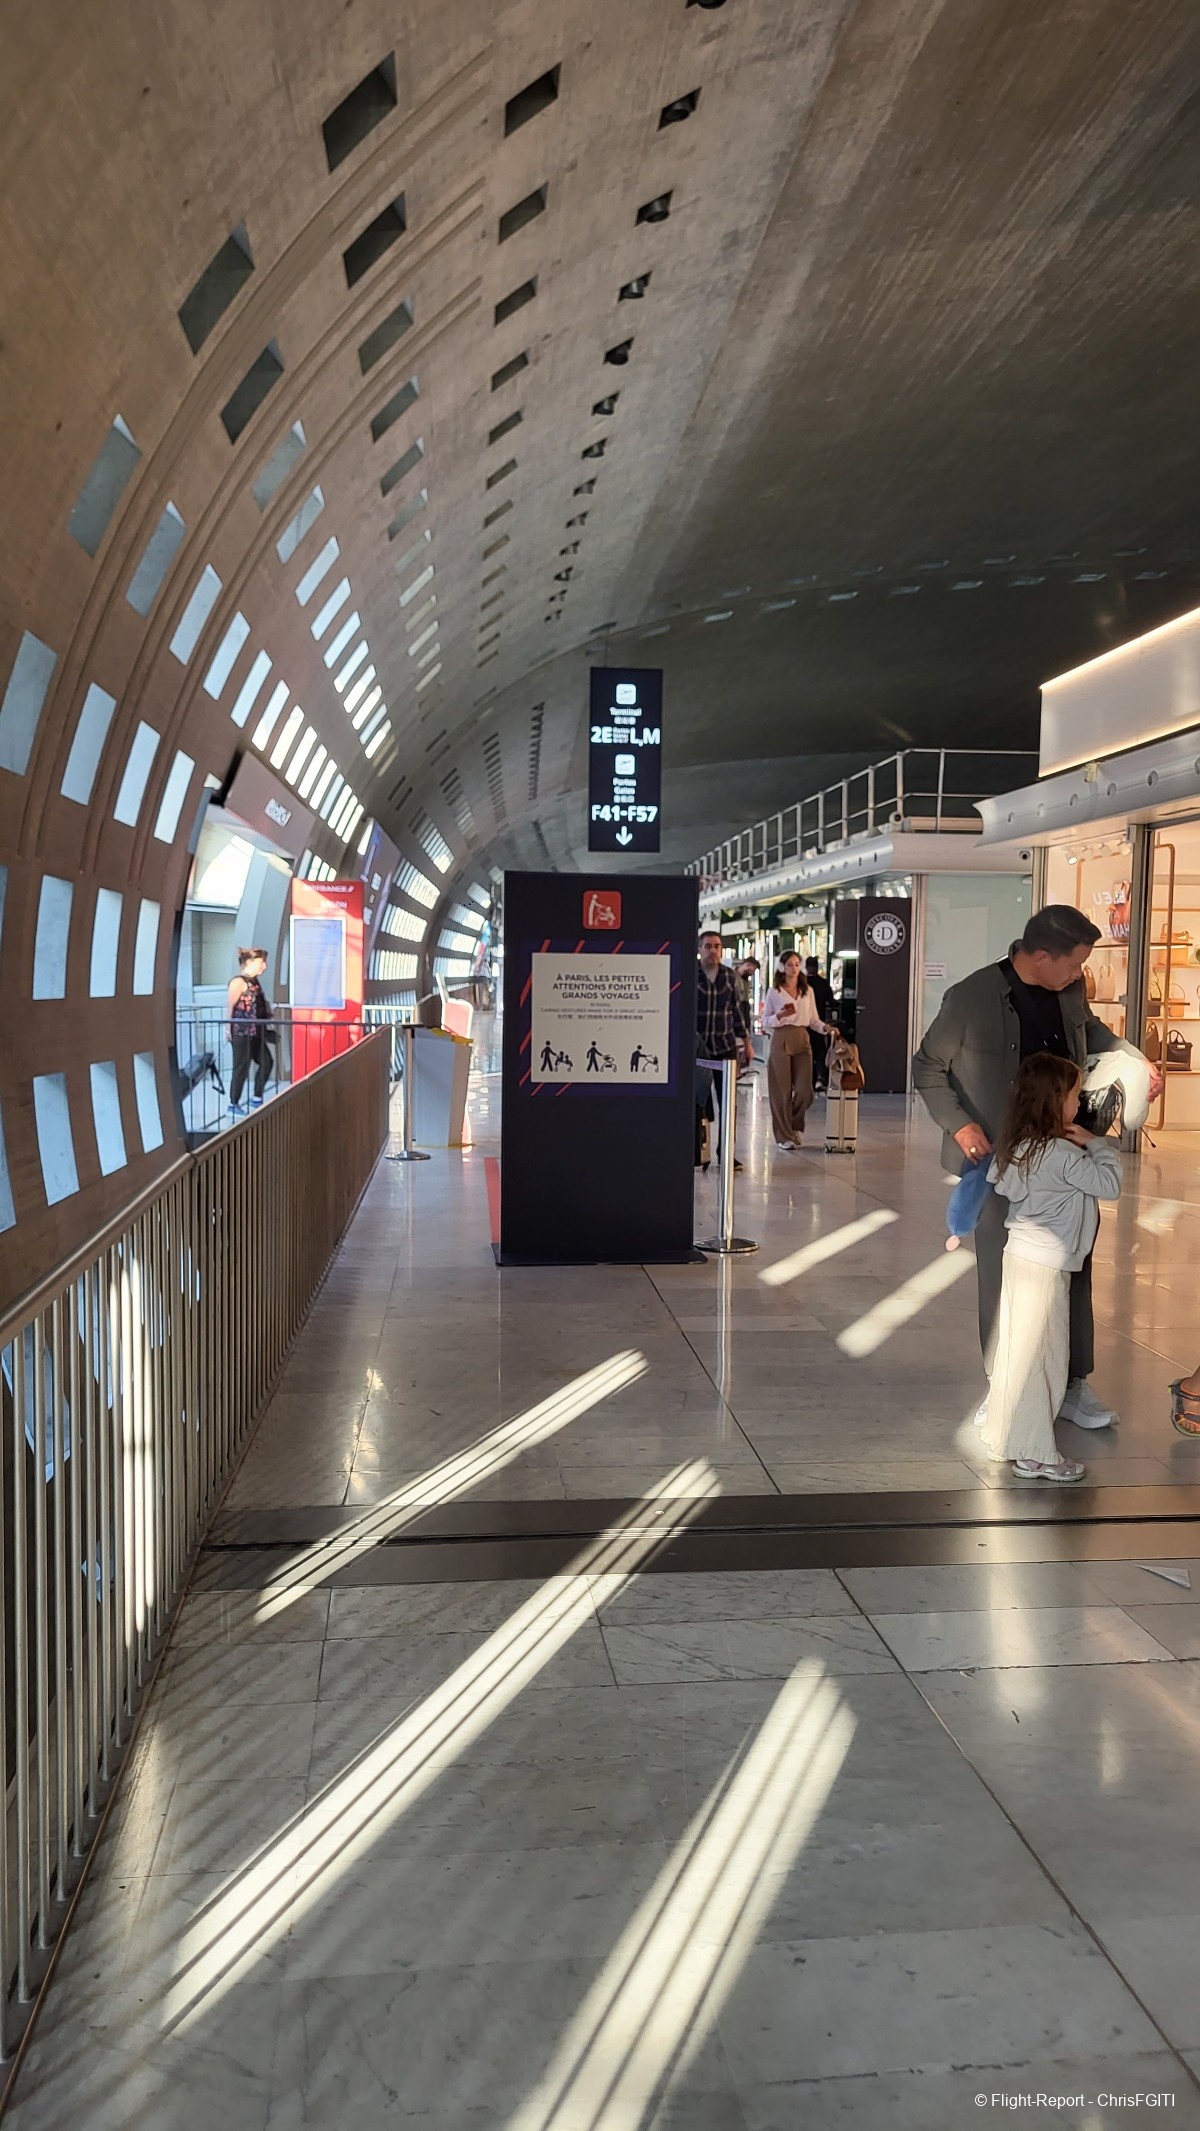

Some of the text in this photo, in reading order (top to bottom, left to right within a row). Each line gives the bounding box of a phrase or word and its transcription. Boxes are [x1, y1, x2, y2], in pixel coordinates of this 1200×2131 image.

[610, 707, 642, 716] Terminal
[591, 726, 613, 743] 2E
[630, 727, 661, 747] L,M
[591, 804, 658, 823] F41-F57
[556, 973, 646, 983] À PARIS, LES PETITES
[552, 983, 650, 992] ATTENTIONS FONT LES
[562, 991, 640, 1000] GRANDS VOYAGES
